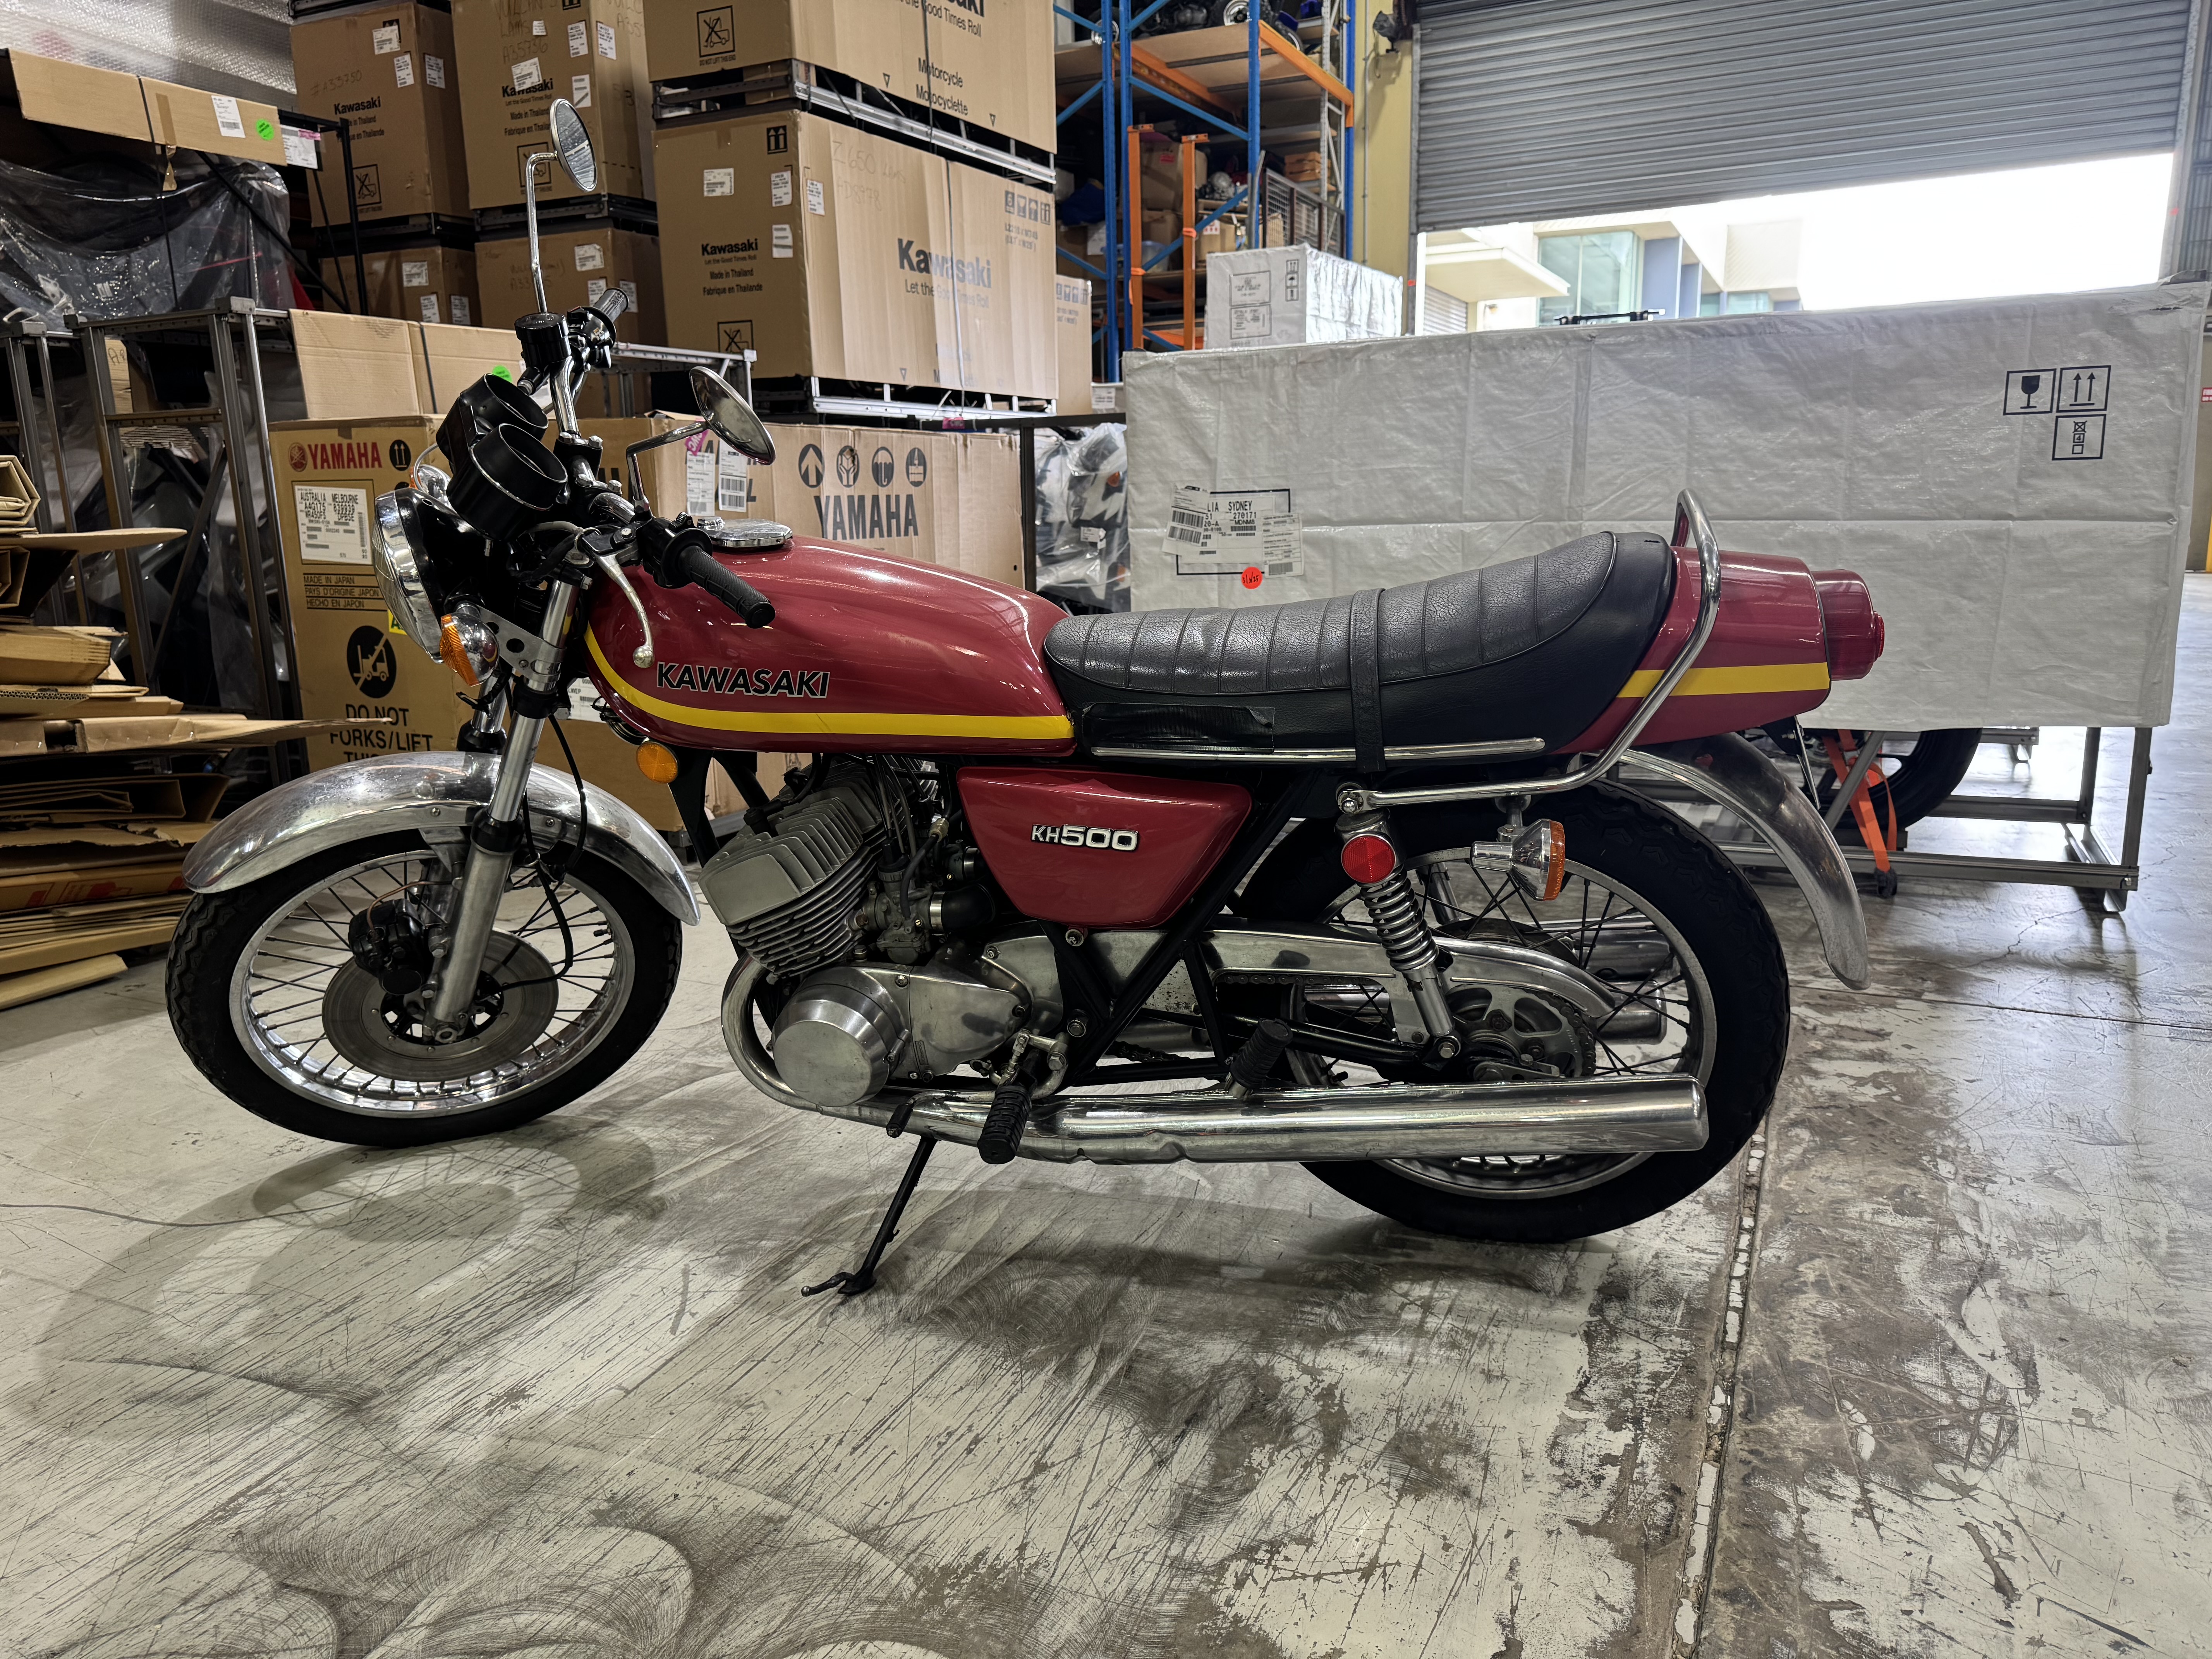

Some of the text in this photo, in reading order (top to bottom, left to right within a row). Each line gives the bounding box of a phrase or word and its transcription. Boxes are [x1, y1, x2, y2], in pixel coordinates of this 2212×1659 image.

[944, 7, 966, 30] Times
[968, 19, 982, 38] Roll
[334, 96, 381, 115] Kawasaki
[701, 238, 758, 256] Kawasaki
[898, 238, 991, 289] Kawasaki
[905, 279, 919, 295] Let
[921, 282, 934, 297] the
[307, 442, 383, 470] YAMAHA
[301, 492, 327, 502] AUSTRALIA
[1228, 501, 1252, 511] SYDNEY
[814, 494, 919, 540] YAMAHA
[304, 576, 322, 584] MADE
[334, 576, 355, 584] JAPAN
[305, 587, 321, 596] PAYS
[358, 589, 379, 597] JAPON
[307, 599, 329, 607] HECHO
[343, 600, 365, 608] JAPON
[657, 661, 830, 699] KAWASAKI
[345, 704, 409, 726] DO NOT
[330, 729, 433, 751] FORKS/LIFT
[1031, 824, 1139, 852] KH500
